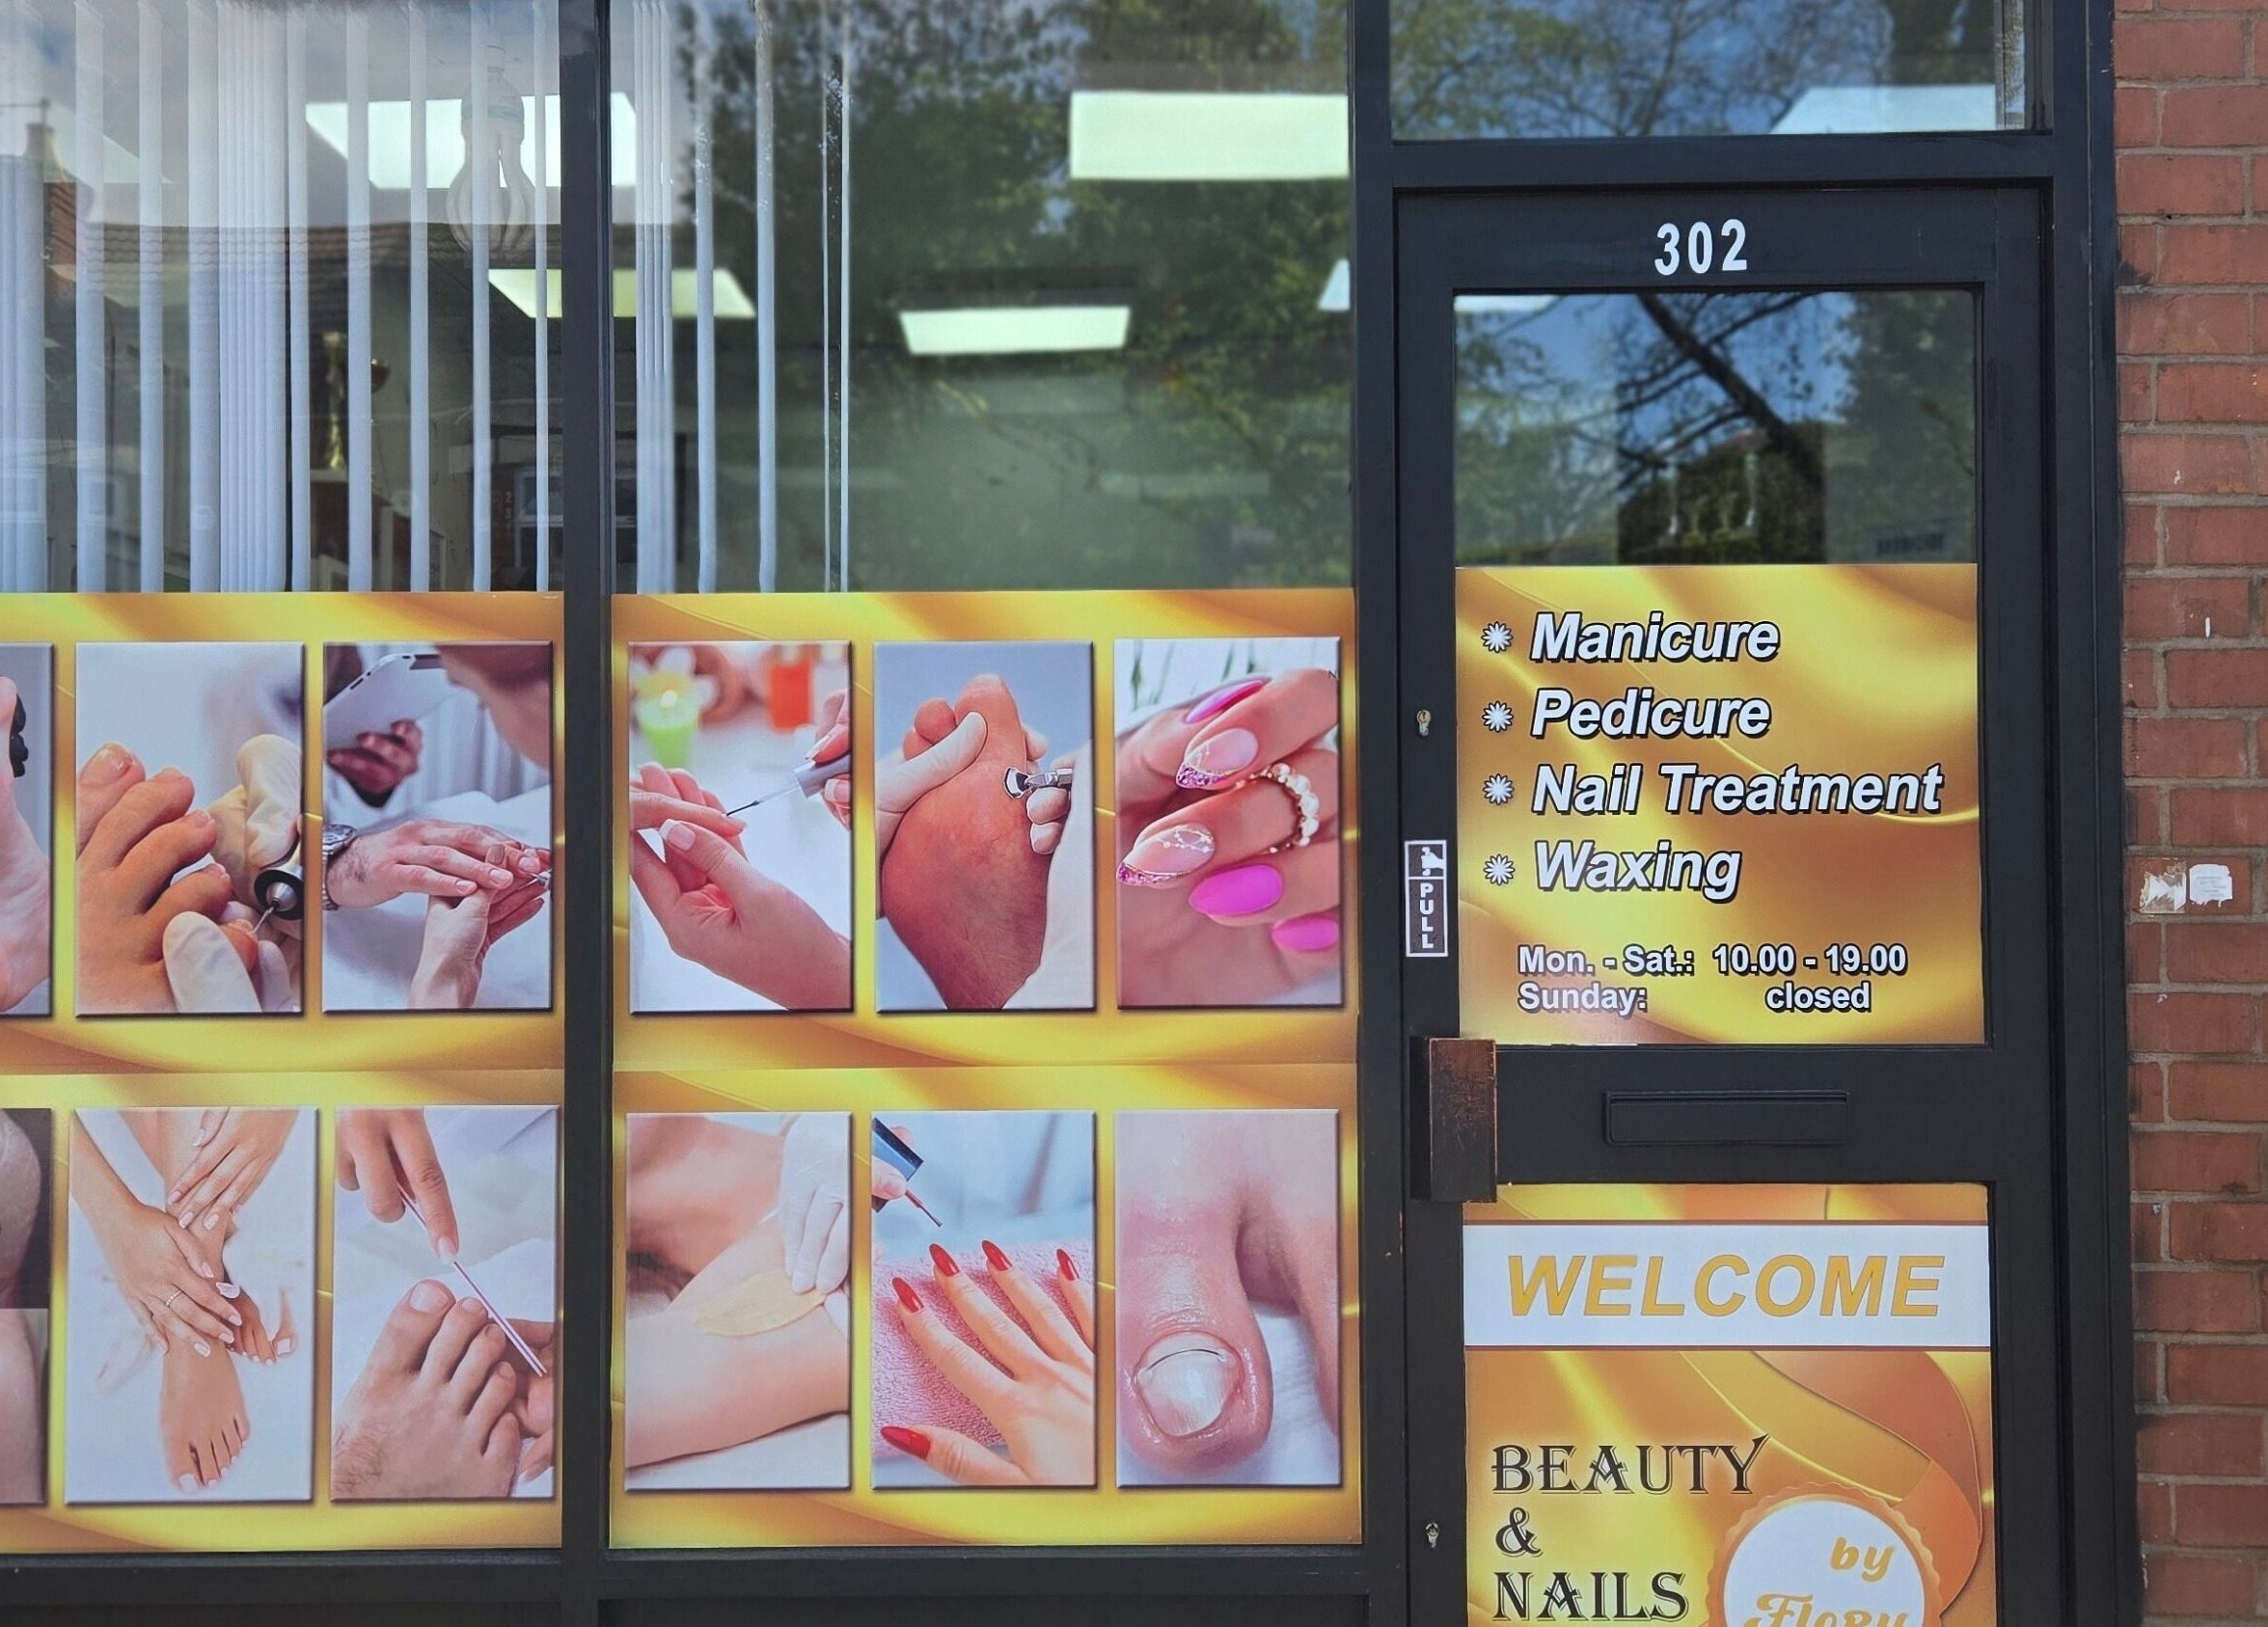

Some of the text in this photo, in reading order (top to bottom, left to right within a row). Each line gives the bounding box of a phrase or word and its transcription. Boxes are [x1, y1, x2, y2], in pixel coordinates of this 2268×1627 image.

[1654, 218, 1747, 276] 302
[1530, 611, 1781, 663] Manicure
[1530, 687, 1772, 738] Pedicure
[1532, 763, 1944, 815] Nail Treatment
[1535, 840, 1742, 903] Waxing
[1419, 881, 1435, 949] PULL
[1518, 945, 1595, 977] Mon.
[1624, 944, 1695, 976] Sat.:
[1712, 944, 1794, 976] 10.00
[1825, 943, 1907, 976] 19.00
[1518, 981, 1872, 1017] Sunday: closed
[1508, 1254, 1946, 1318] WELCOME
[1490, 1434, 1770, 1495] BEAUTY
[1494, 1506, 1544, 1558] &
[1830, 1536, 1895, 1583] by
[1492, 1571, 1689, 1622] NAILS
